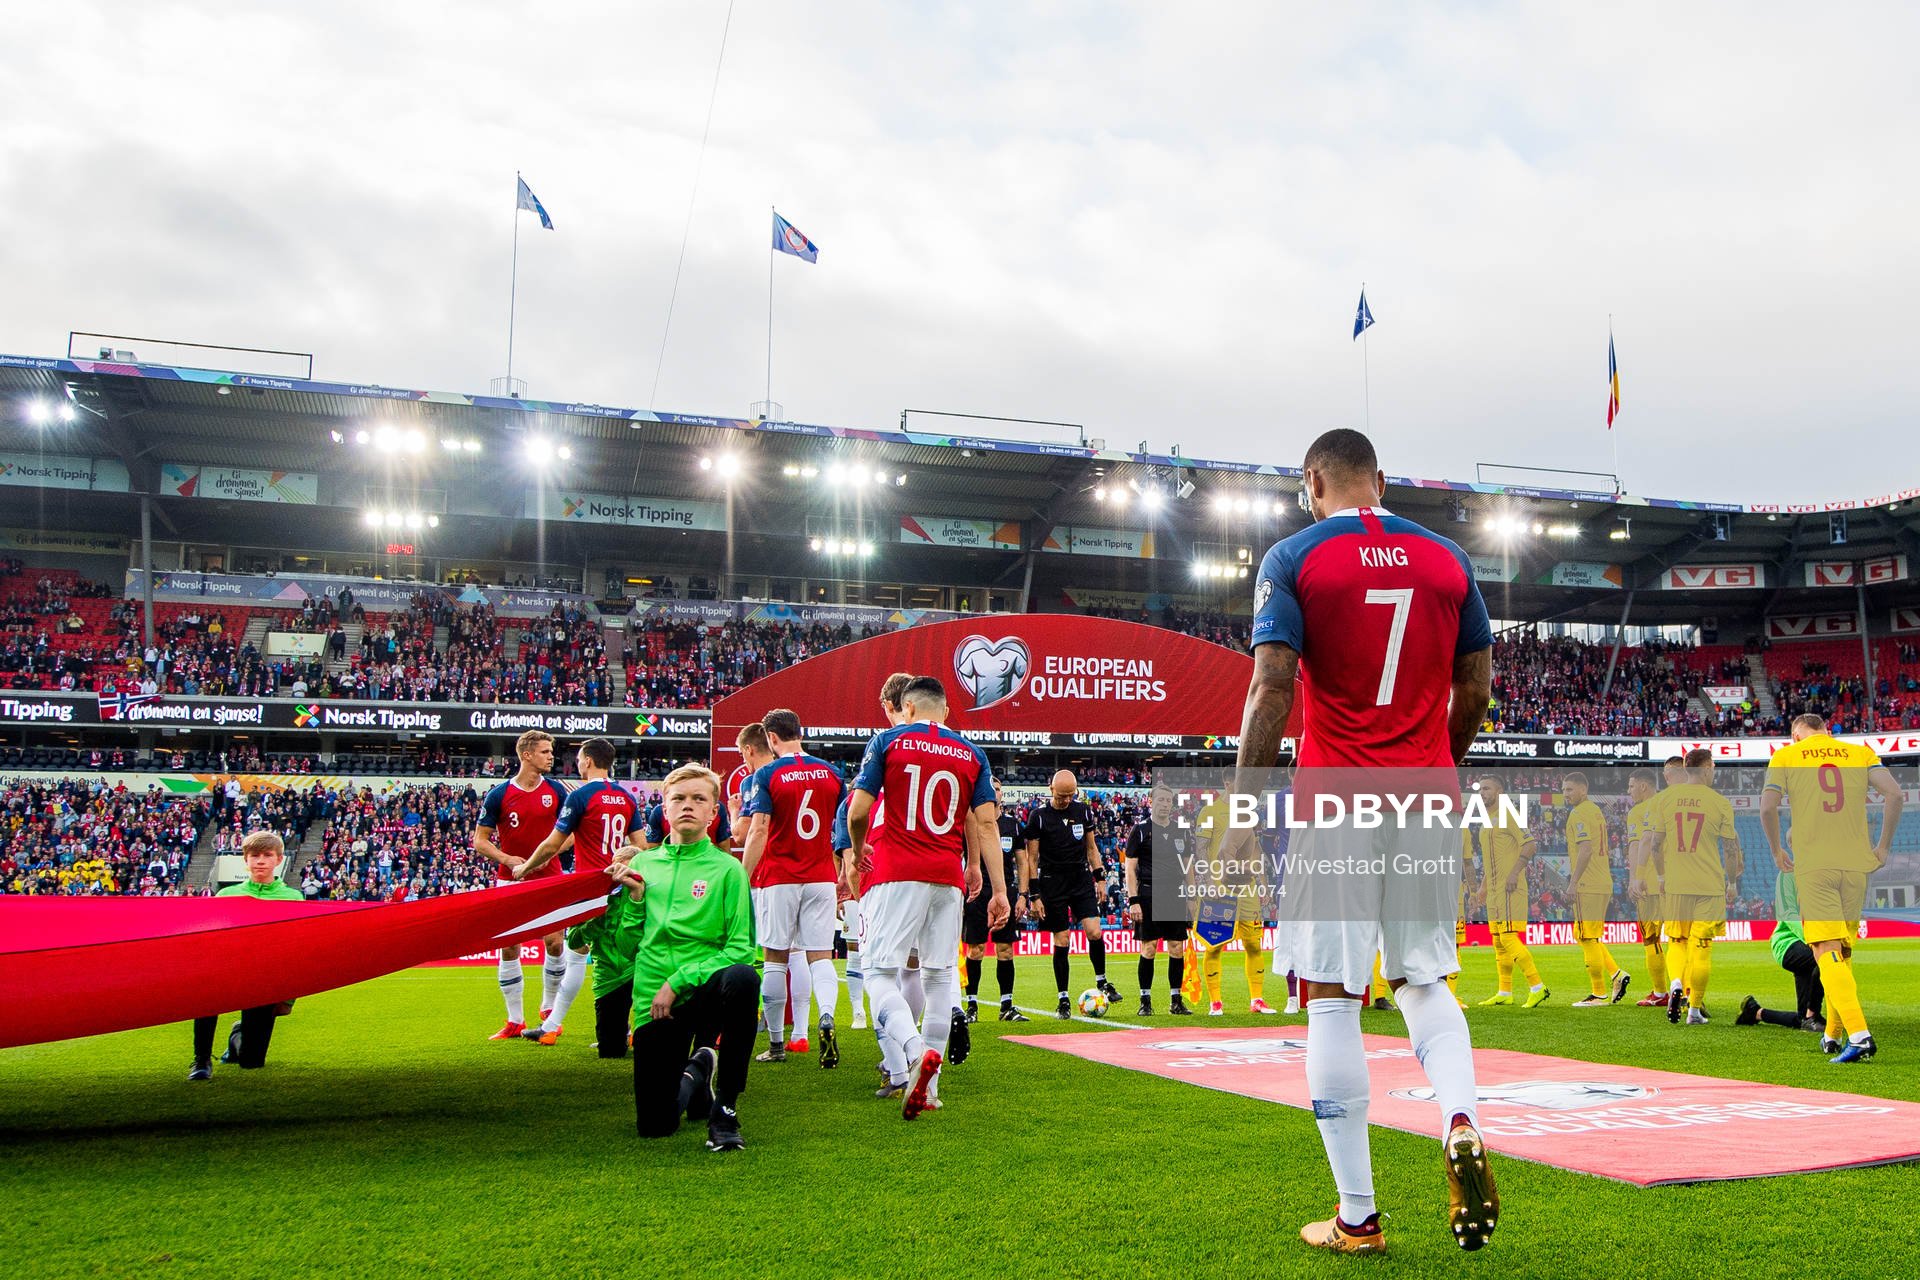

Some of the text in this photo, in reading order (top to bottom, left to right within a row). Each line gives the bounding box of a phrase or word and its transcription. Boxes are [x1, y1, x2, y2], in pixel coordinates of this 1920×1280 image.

[251, 378, 292, 389] Norsk Tipping
[17, 466, 98, 482] Norsk Tipping
[216, 475, 258, 489] drømmen
[232, 470, 241, 479] Gi
[234, 486, 265, 500] sjanse!
[590, 502, 694, 526] Norsk Tipping
[953, 520, 961, 529] Gi
[957, 534, 980, 547] sjanse!
[1079, 537, 1133, 551] Norsk Tipping
[387, 544, 413, 555] 20:40
[1358, 546, 1409, 568] KING
[1477, 566, 1502, 577] Tipping
[1674, 567, 1752, 587] VG
[1818, 560, 1895, 585] VG
[171, 578, 242, 594] Norsk Tipping
[325, 584, 337, 597] Gi
[378, 589, 390, 599] en
[517, 596, 544, 606] Norsk
[674, 604, 733, 618] Norsk Tipping
[801, 609, 812, 621] Gi
[846, 613, 856, 621] en
[856, 611, 883, 624] sjanse!
[1773, 612, 1856, 637] VG
[1364, 588, 1415, 707] 7
[1045, 656, 1153, 677] EUROPEAN
[1030, 676, 1167, 701] QUALIFIERS
[2, 700, 73, 722] Tipping
[128, 704, 190, 721] drømmen
[193, 705, 210, 720] en
[213, 704, 264, 725] sjanse!
[325, 708, 441, 730] Norsk Tipping
[470, 711, 608, 734] Gi drømmen en sjanse!
[662, 718, 708, 734] Norsk
[960, 730, 1001, 741] Norsk
[1134, 735, 1147, 745] en
[1147, 735, 1183, 748] sjanse!
[902, 740, 973, 763] ELYOUNOUSSI
[1467, 740, 1538, 757] orsk Tipping
[1554, 741, 1566, 756] Gi
[1614, 742, 1644, 759] sjanse!
[780, 769, 830, 784] NORDTVEIT
[1817, 762, 1846, 814] 9
[601, 794, 627, 806] SELNÆS
[903, 763, 961, 836] 10
[1676, 798, 1702, 808] DEAC
[509, 811, 520, 828] 3
[796, 789, 821, 841] 6
[600, 813, 627, 856] 18
[1674, 811, 1706, 853] 17
[1480, 1103, 1897, 1137] QUALIFIERS
[1486, 1098, 1799, 1127] EUROPEAN
